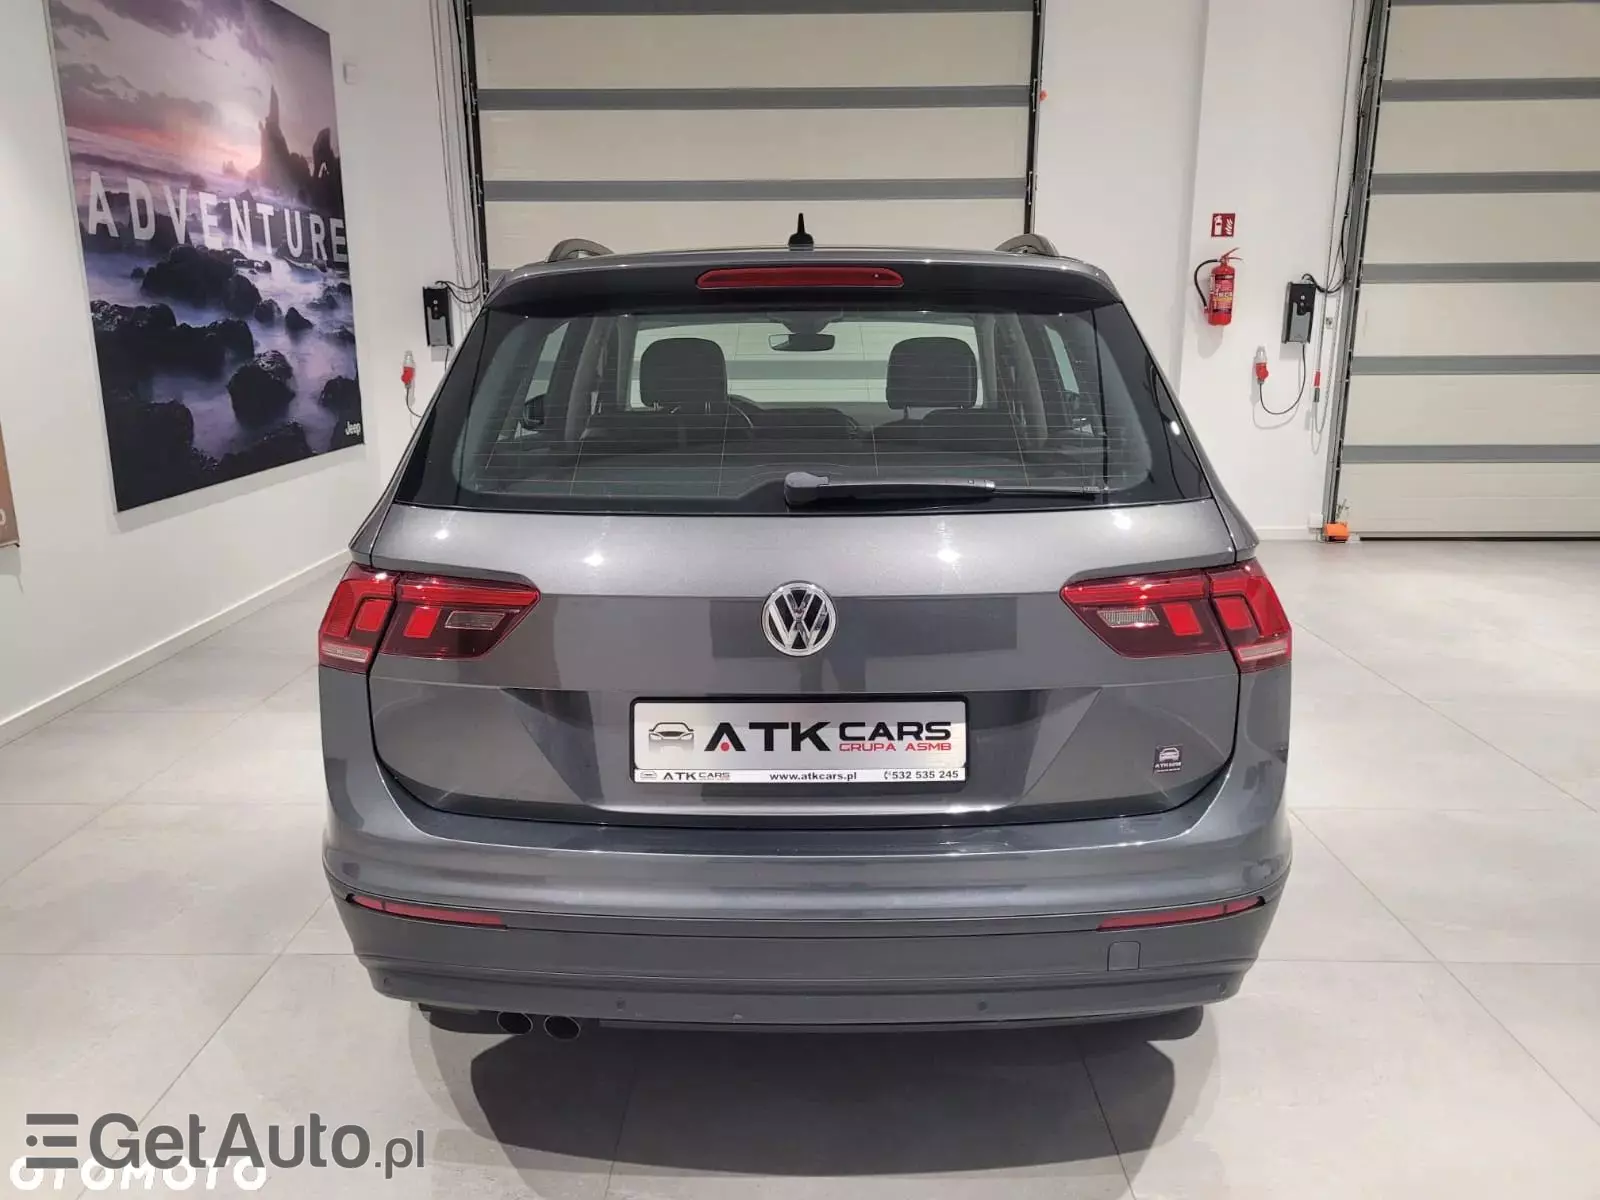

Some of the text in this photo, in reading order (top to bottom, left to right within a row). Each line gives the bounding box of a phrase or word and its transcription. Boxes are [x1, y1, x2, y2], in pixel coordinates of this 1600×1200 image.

[88, 171, 347, 263] ADVENTURE
[704, 721, 951, 752] ATK CARS
[839, 742, 952, 752] GRUPA ASMB
[663, 772, 697, 781] ATK
[769, 771, 857, 781] www.atkcars.pl
[892, 770, 959, 780] 532 535 245
